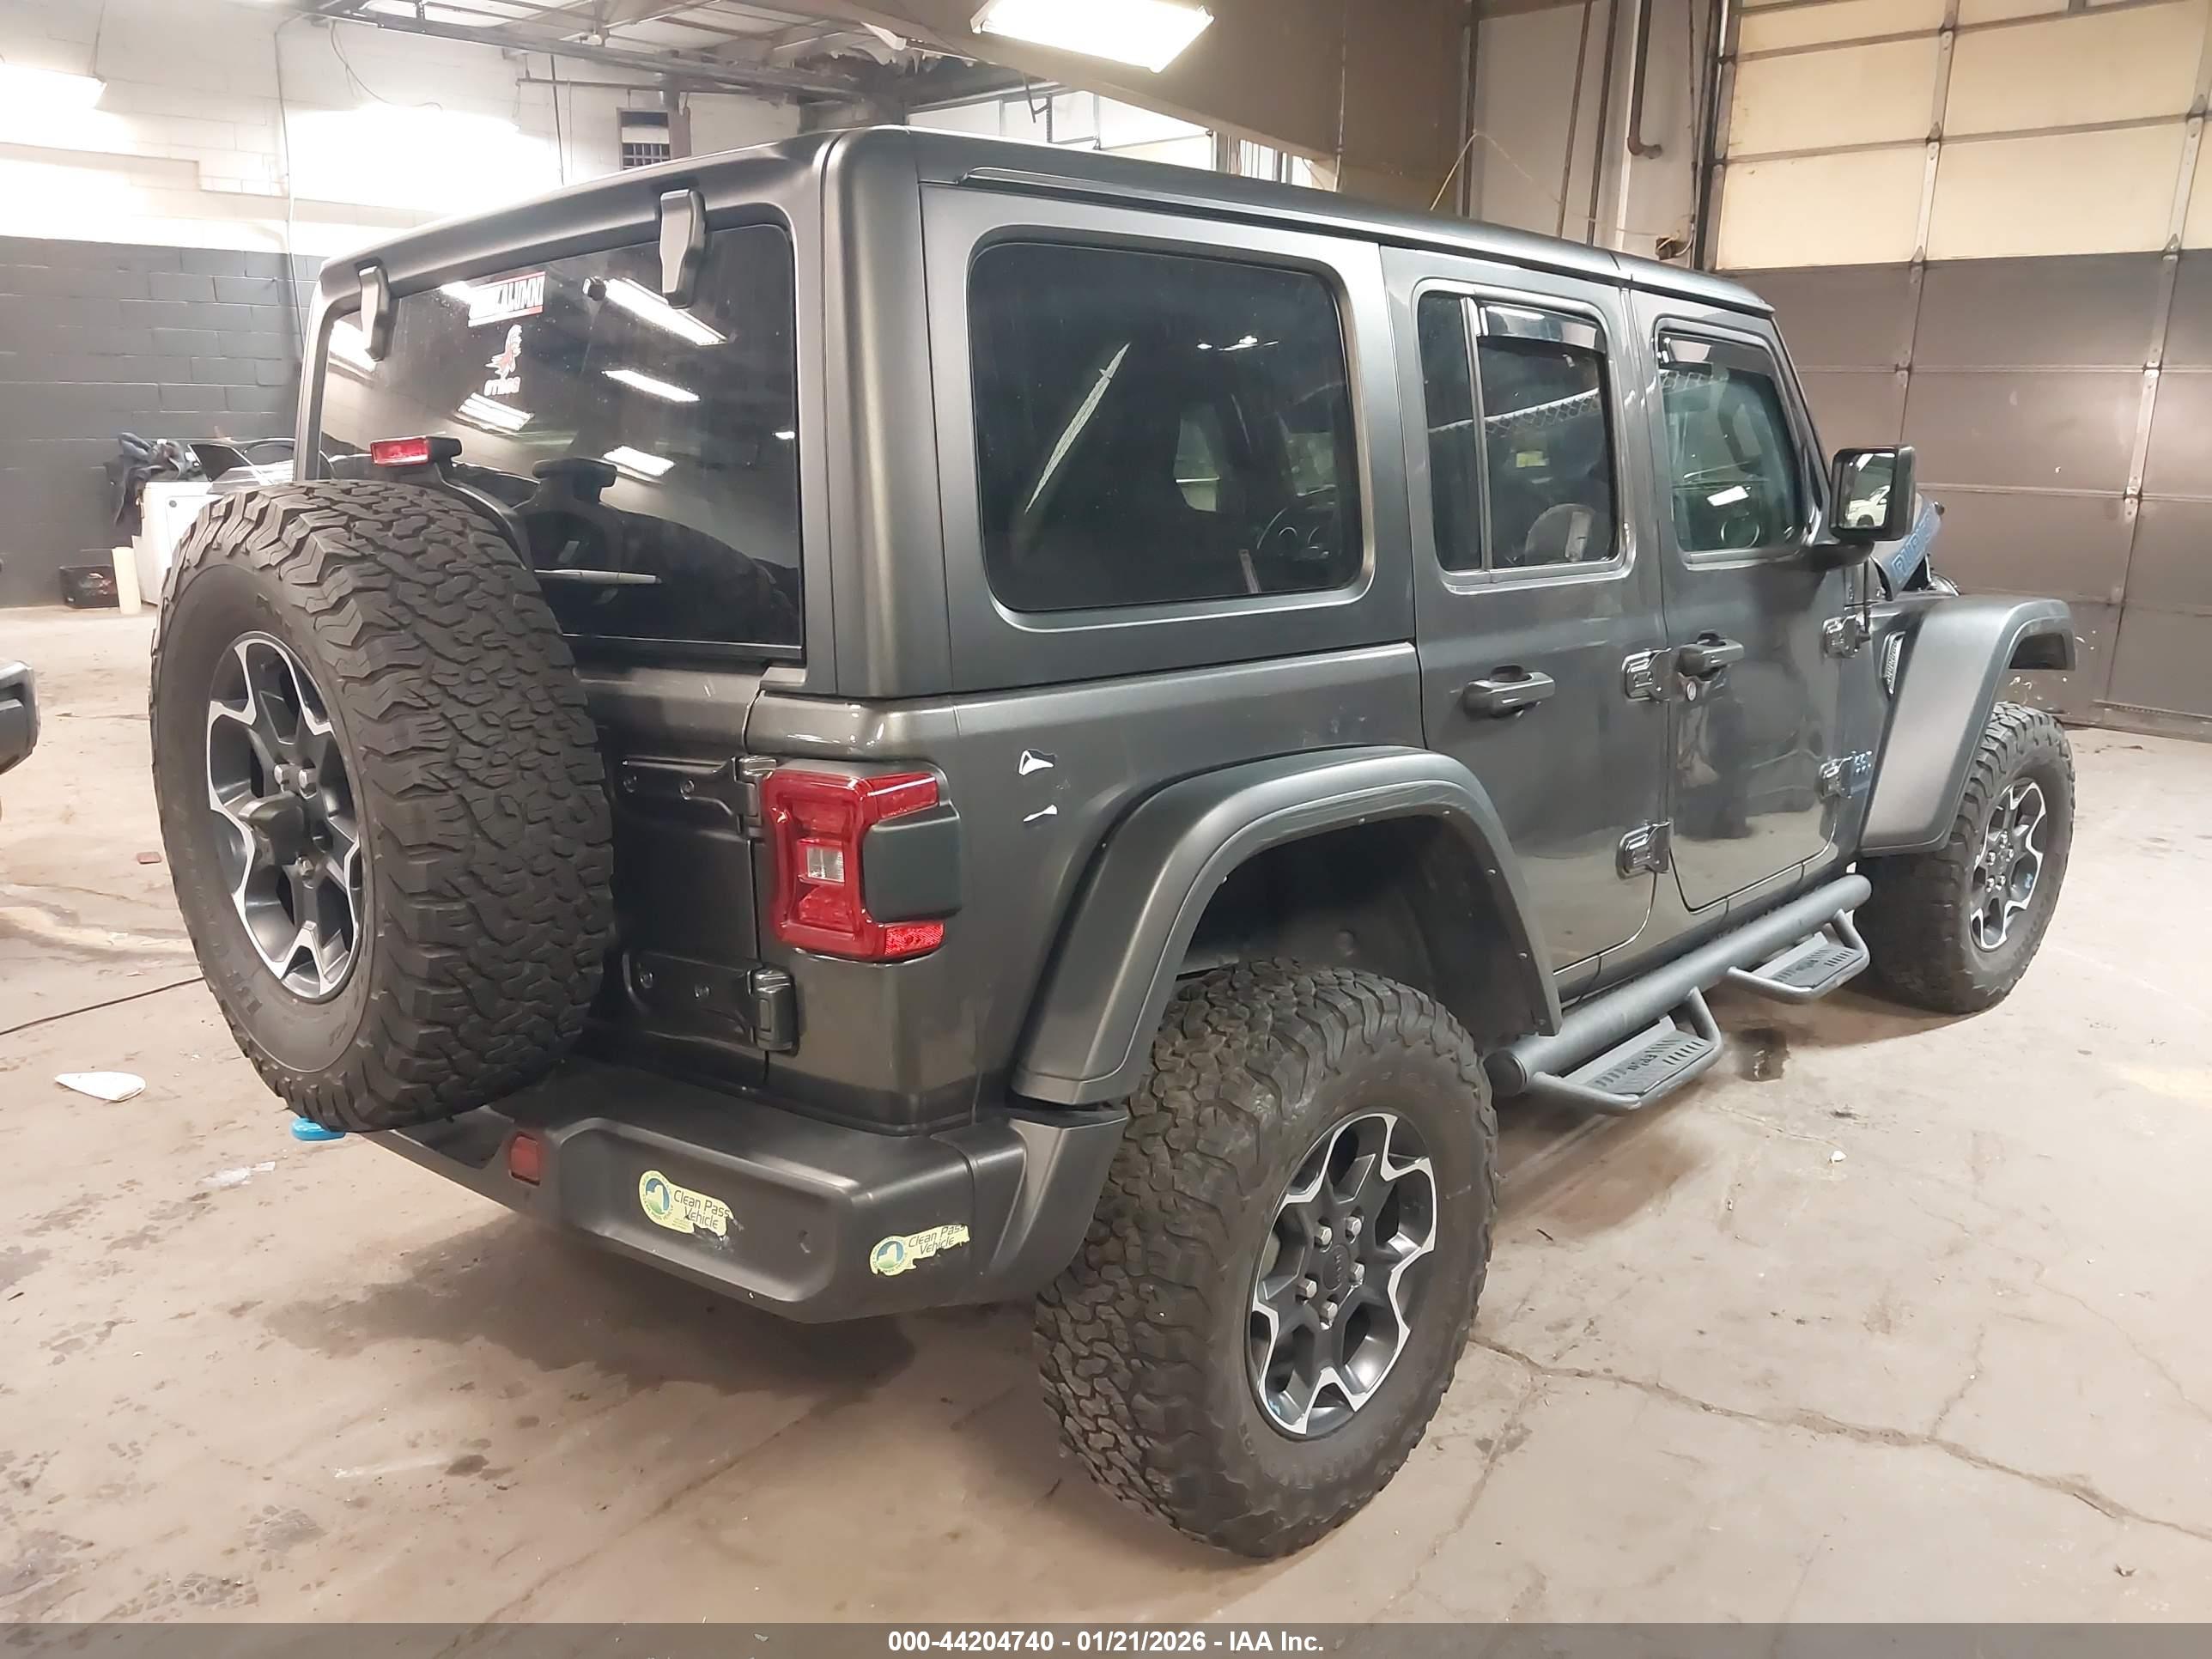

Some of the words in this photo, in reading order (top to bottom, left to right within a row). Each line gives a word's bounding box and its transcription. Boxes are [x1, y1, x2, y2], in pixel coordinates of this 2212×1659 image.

[673, 1189, 702, 1211] Clean
[704, 1200, 732, 1219] Pass
[684, 1206, 720, 1229] Vehicle
[908, 1231, 938, 1248] Clean
[940, 1224, 966, 1238] Pass
[920, 1237, 955, 1255] Vehicle
